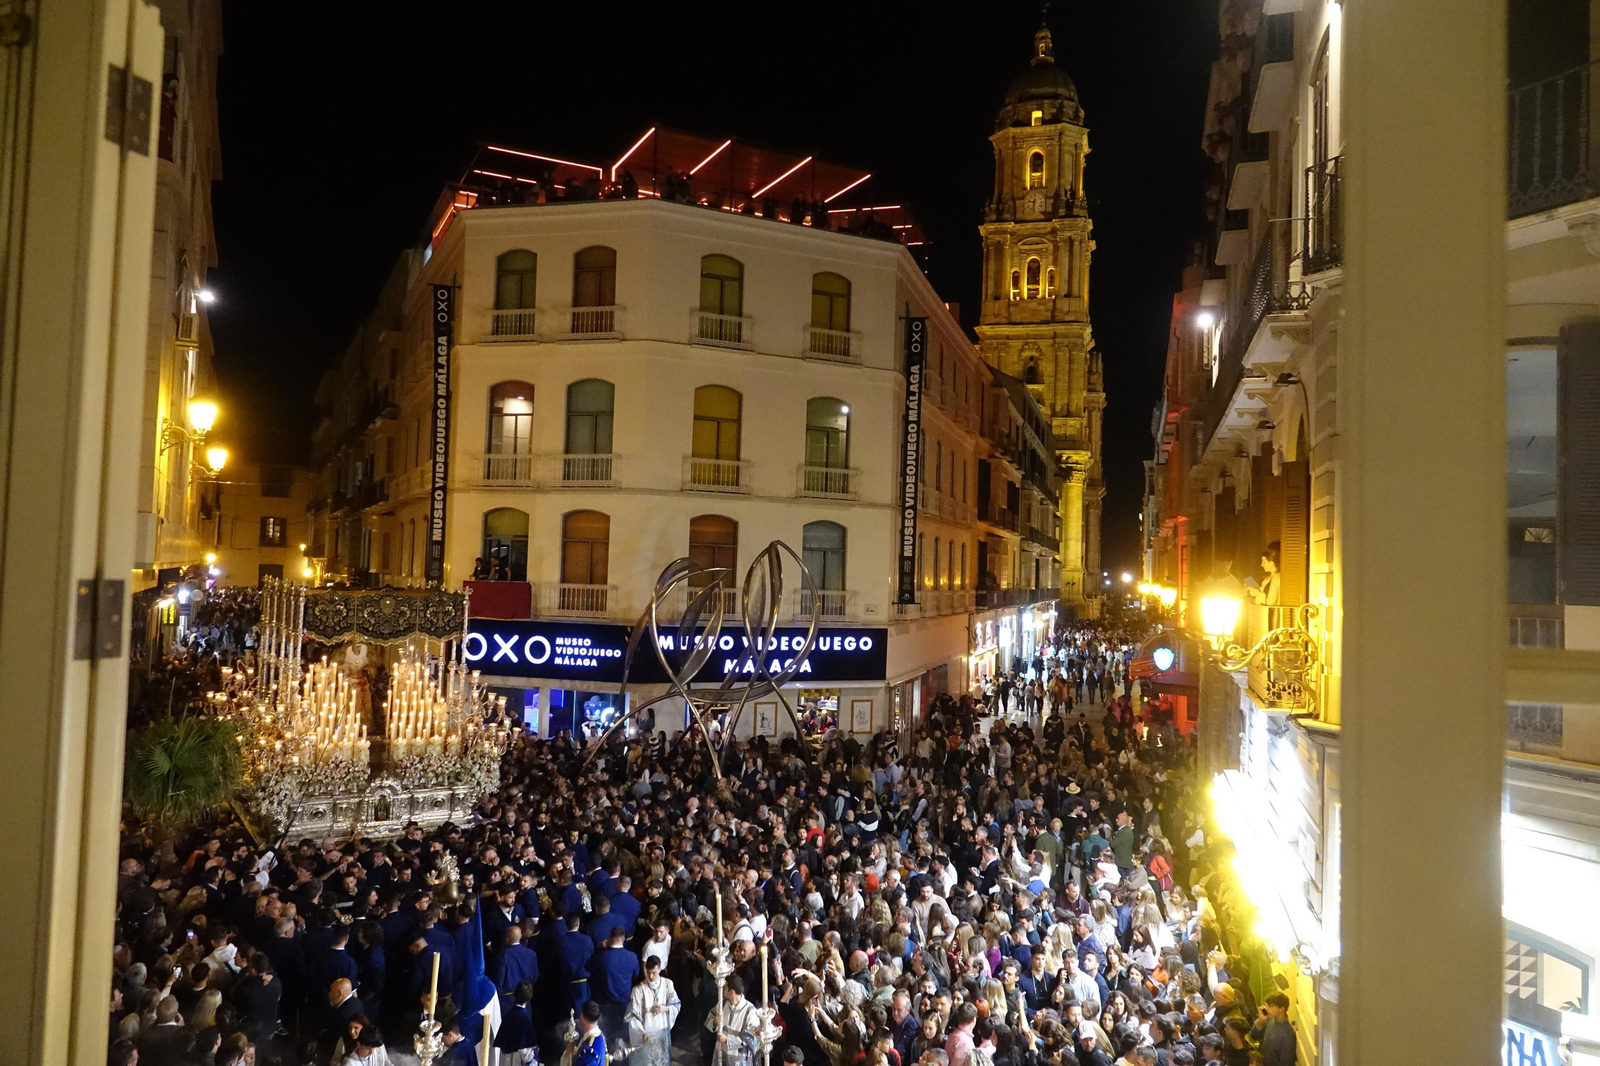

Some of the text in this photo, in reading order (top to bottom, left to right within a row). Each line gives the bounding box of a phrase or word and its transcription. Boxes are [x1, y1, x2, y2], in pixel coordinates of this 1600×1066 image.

[437, 289, 448, 323] OXO
[911, 321, 922, 353] OXO
[435, 336, 448, 396] MÁLAGA
[908, 364, 920, 421] MÁLAGA
[434, 398, 447, 488] VIDEOJUEGO
[906, 423, 918, 507] VIDEOJUEGO
[433, 489, 444, 541] MUSEO
[903, 508, 915, 557] MUSEO
[465, 632, 551, 664] OXO
[555, 637, 592, 646] MUSEO
[555, 646, 622, 658] VIDEOJUEGO
[554, 656, 598, 667] MÁLAGA
[723, 655, 812, 674] MÁAGA
